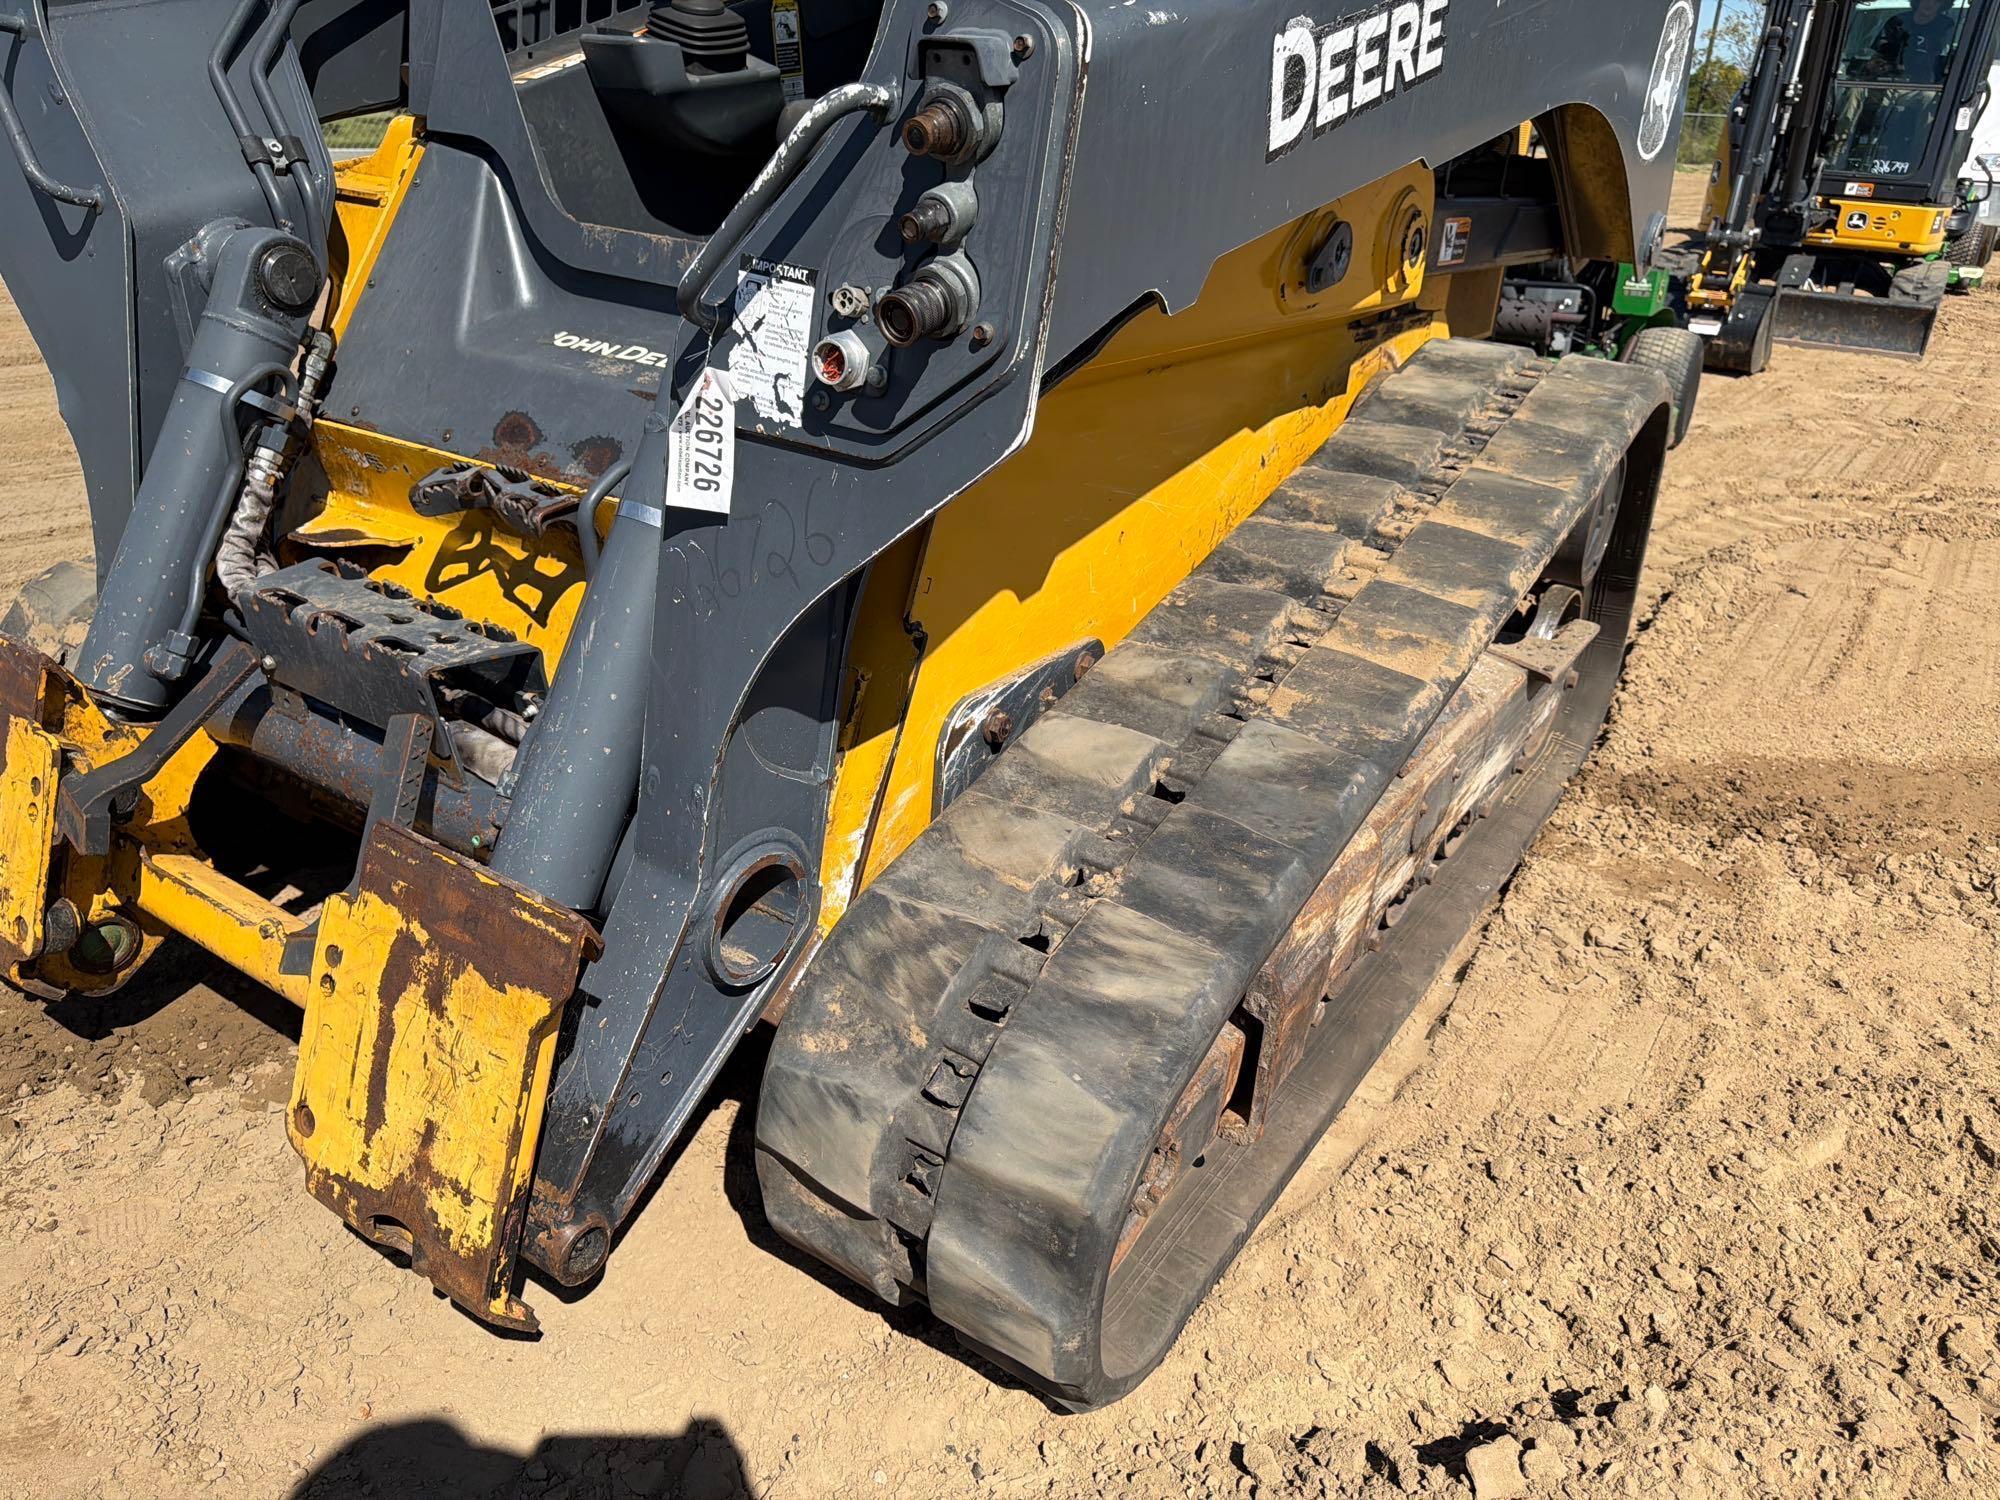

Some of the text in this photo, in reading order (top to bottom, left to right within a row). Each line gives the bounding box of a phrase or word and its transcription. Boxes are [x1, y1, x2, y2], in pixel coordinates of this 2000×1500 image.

[1267, 0, 1450, 154] DEERE
[752, 258, 809, 281] IMPORTANT
[693, 396, 724, 493] 226726
